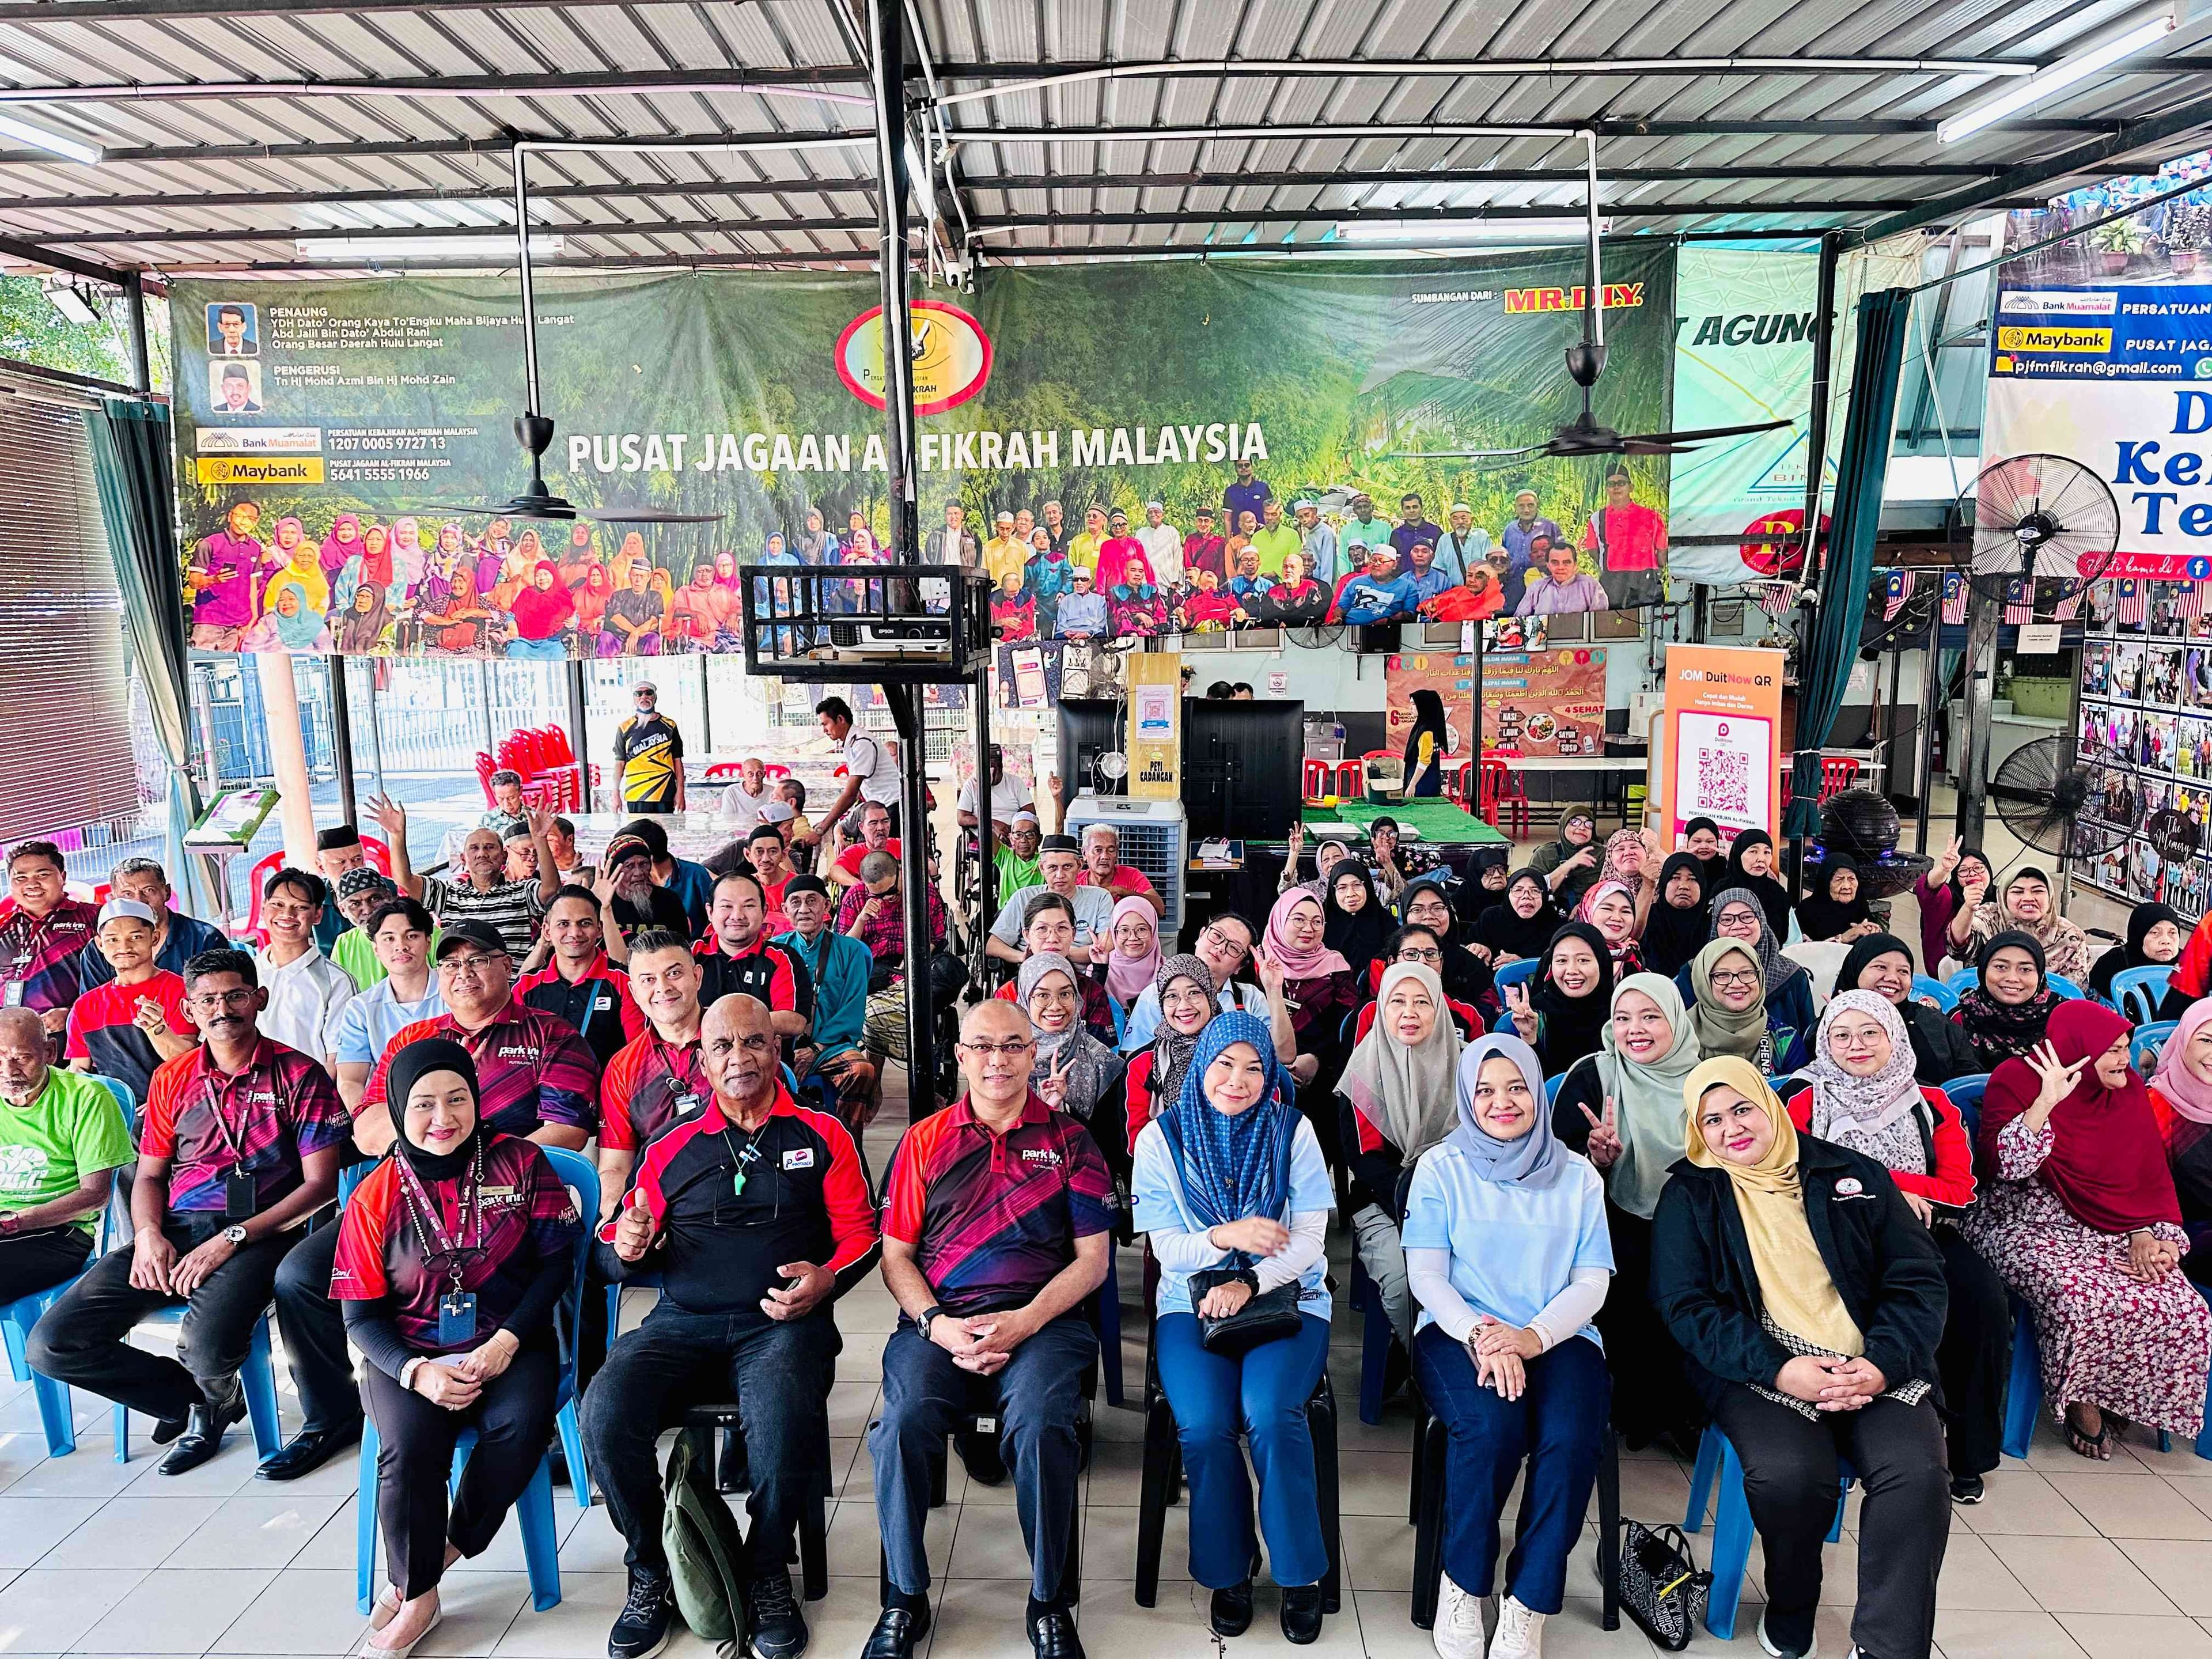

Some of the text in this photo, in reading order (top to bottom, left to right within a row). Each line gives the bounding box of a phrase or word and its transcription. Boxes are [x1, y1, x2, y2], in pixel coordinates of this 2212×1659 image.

[1411, 292, 1469, 304] SUMBANGAN
[270, 308, 328, 317] PENAUNG
[2043, 302, 2111, 311] Bank Muamalat
[2122, 304, 2211, 315] PERSATUAN
[270, 319, 294, 328] YDH
[328, 318, 361, 329] Orang
[364, 318, 390, 328] Kaya
[445, 317, 472, 325] Maha
[475, 316, 508, 327] Bijaya
[537, 315, 574, 325] Langat
[272, 329, 293, 338] Abd
[297, 329, 317, 338] Jalil
[321, 329, 338, 338] Bin
[373, 328, 403, 337] Abdul
[407, 328, 430, 337] Rani
[272, 338, 444, 350] Orang Besar Daerah Hulu Langat
[2025, 333, 2104, 349] Maybank
[2126, 339, 2175, 351] PUSAT
[274, 365, 340, 375] PENGERUSI
[2015, 358, 2182, 375] pjfmfikrah@gmail.com
[274, 375, 456, 388] Tn Hj Mohd Azmi Bin Hj Mohd Zain
[2169, 391, 2212, 434] D
[327, 429, 366, 437] PERSATUAN
[407, 428, 442, 436] AL-FIKRAH
[444, 427, 478, 435] MALAYSIA
[243, 438, 317, 448] Bank Muamalat
[328, 437, 446, 450] 1207 0005 9727 13
[568, 433, 688, 473] PUSAT
[694, 433, 850, 472] JAGAAN
[1072, 422, 1268, 467] MALAYSIA
[329, 460, 351, 468] PUSAT
[380, 459, 415, 467] AL-FIKRAH
[2111, 441, 2212, 486] Ke
[233, 464, 308, 480] Maybank
[330, 468, 430, 481] 5641 5555 1966
[2132, 493, 2212, 536] Te
[2126, 556, 2154, 574] kami
[2158, 556, 2172, 574] di
[1679, 669, 1771, 687] JOM DuitNow QR
[1391, 710, 1399, 726] 6
[1502, 713, 1517, 721] NASI
[1503, 729, 1519, 737] LAUK
[1558, 731, 1576, 739] SAYUR
[633, 733, 668, 756] MALAYSIA
[1560, 744, 1577, 752] SUSU
[1150, 761, 1162, 772] PETI
[1140, 772, 1173, 782] CADANGAN
[1688, 810, 1715, 819] PERSATUAN
[2165, 815, 2182, 835] The
[2153, 829, 2192, 860] Memory
[498, 1045, 525, 1058] park
[253, 1091, 276, 1103] park
[1022, 1149, 1048, 1160] park
[505, 1194, 525, 1203] inn
